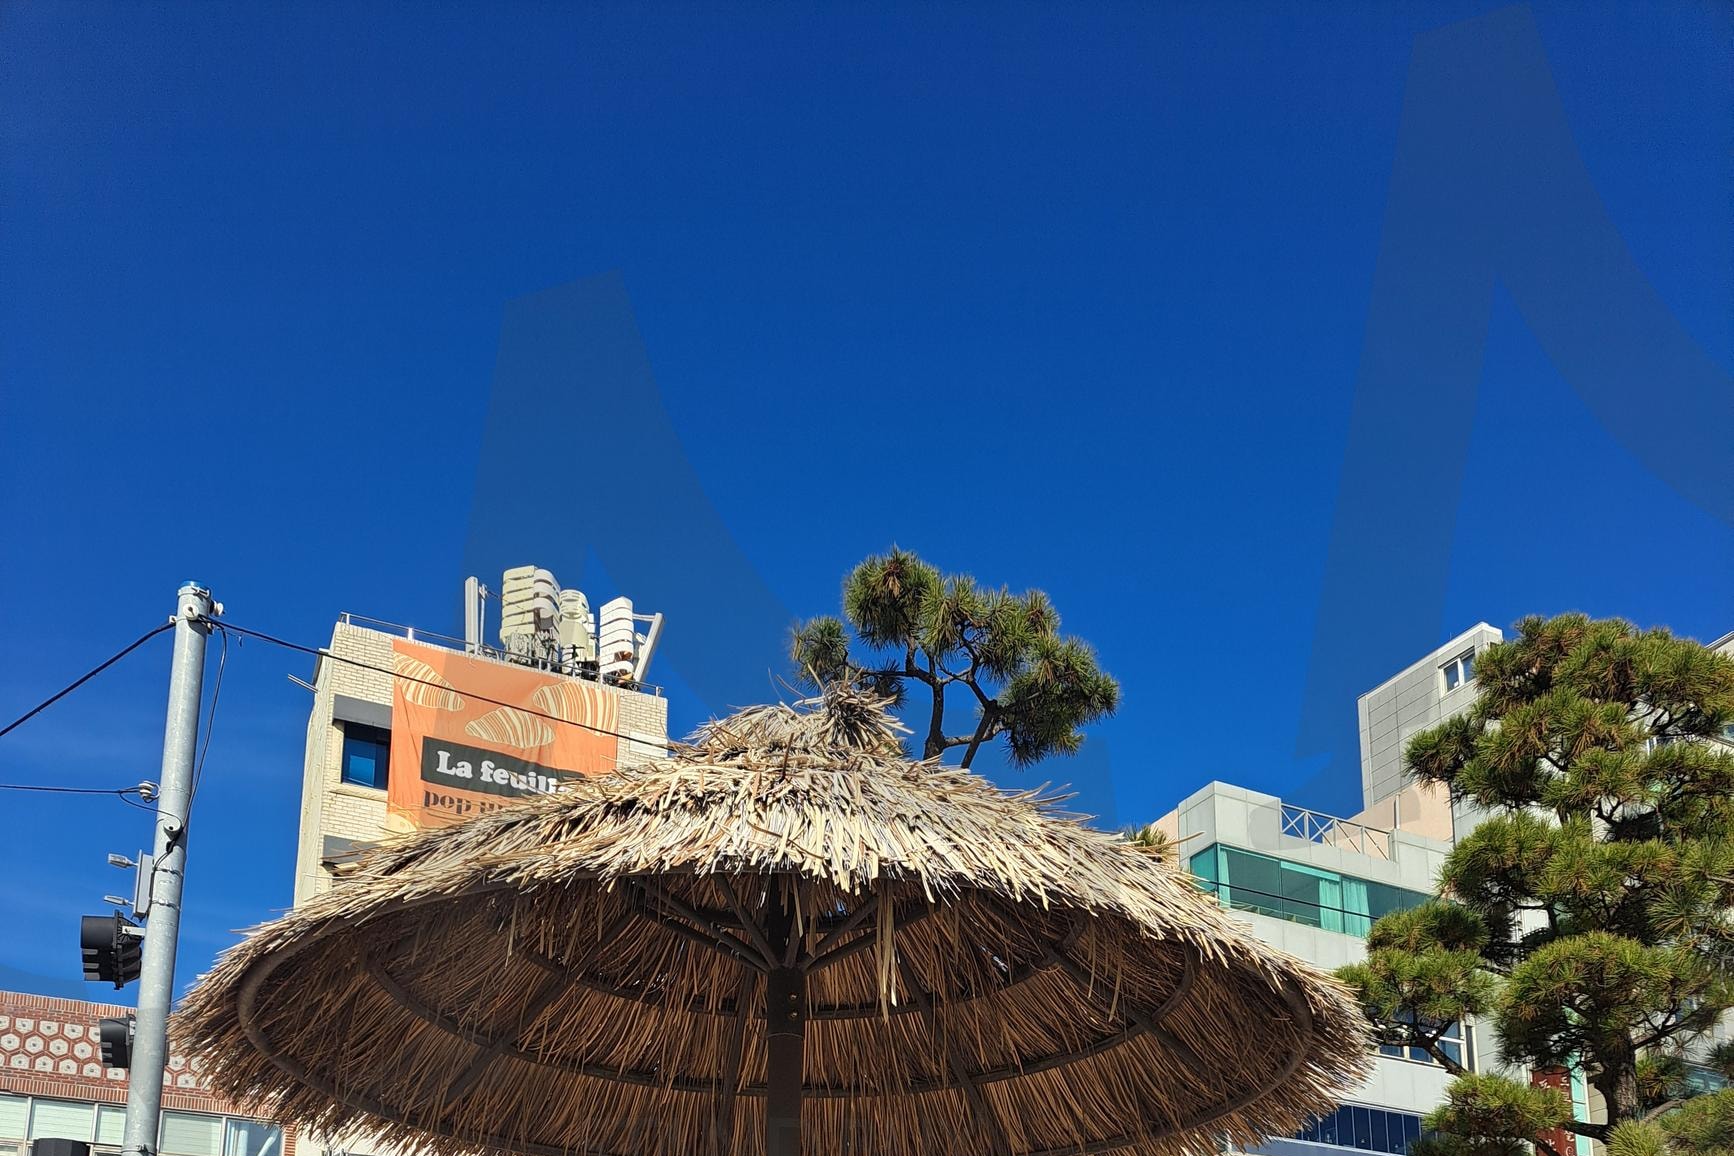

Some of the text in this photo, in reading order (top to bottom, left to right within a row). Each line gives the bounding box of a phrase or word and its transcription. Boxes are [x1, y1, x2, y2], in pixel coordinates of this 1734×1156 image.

[436, 750, 567, 795] La feuill
[424, 789, 472, 815] pop
